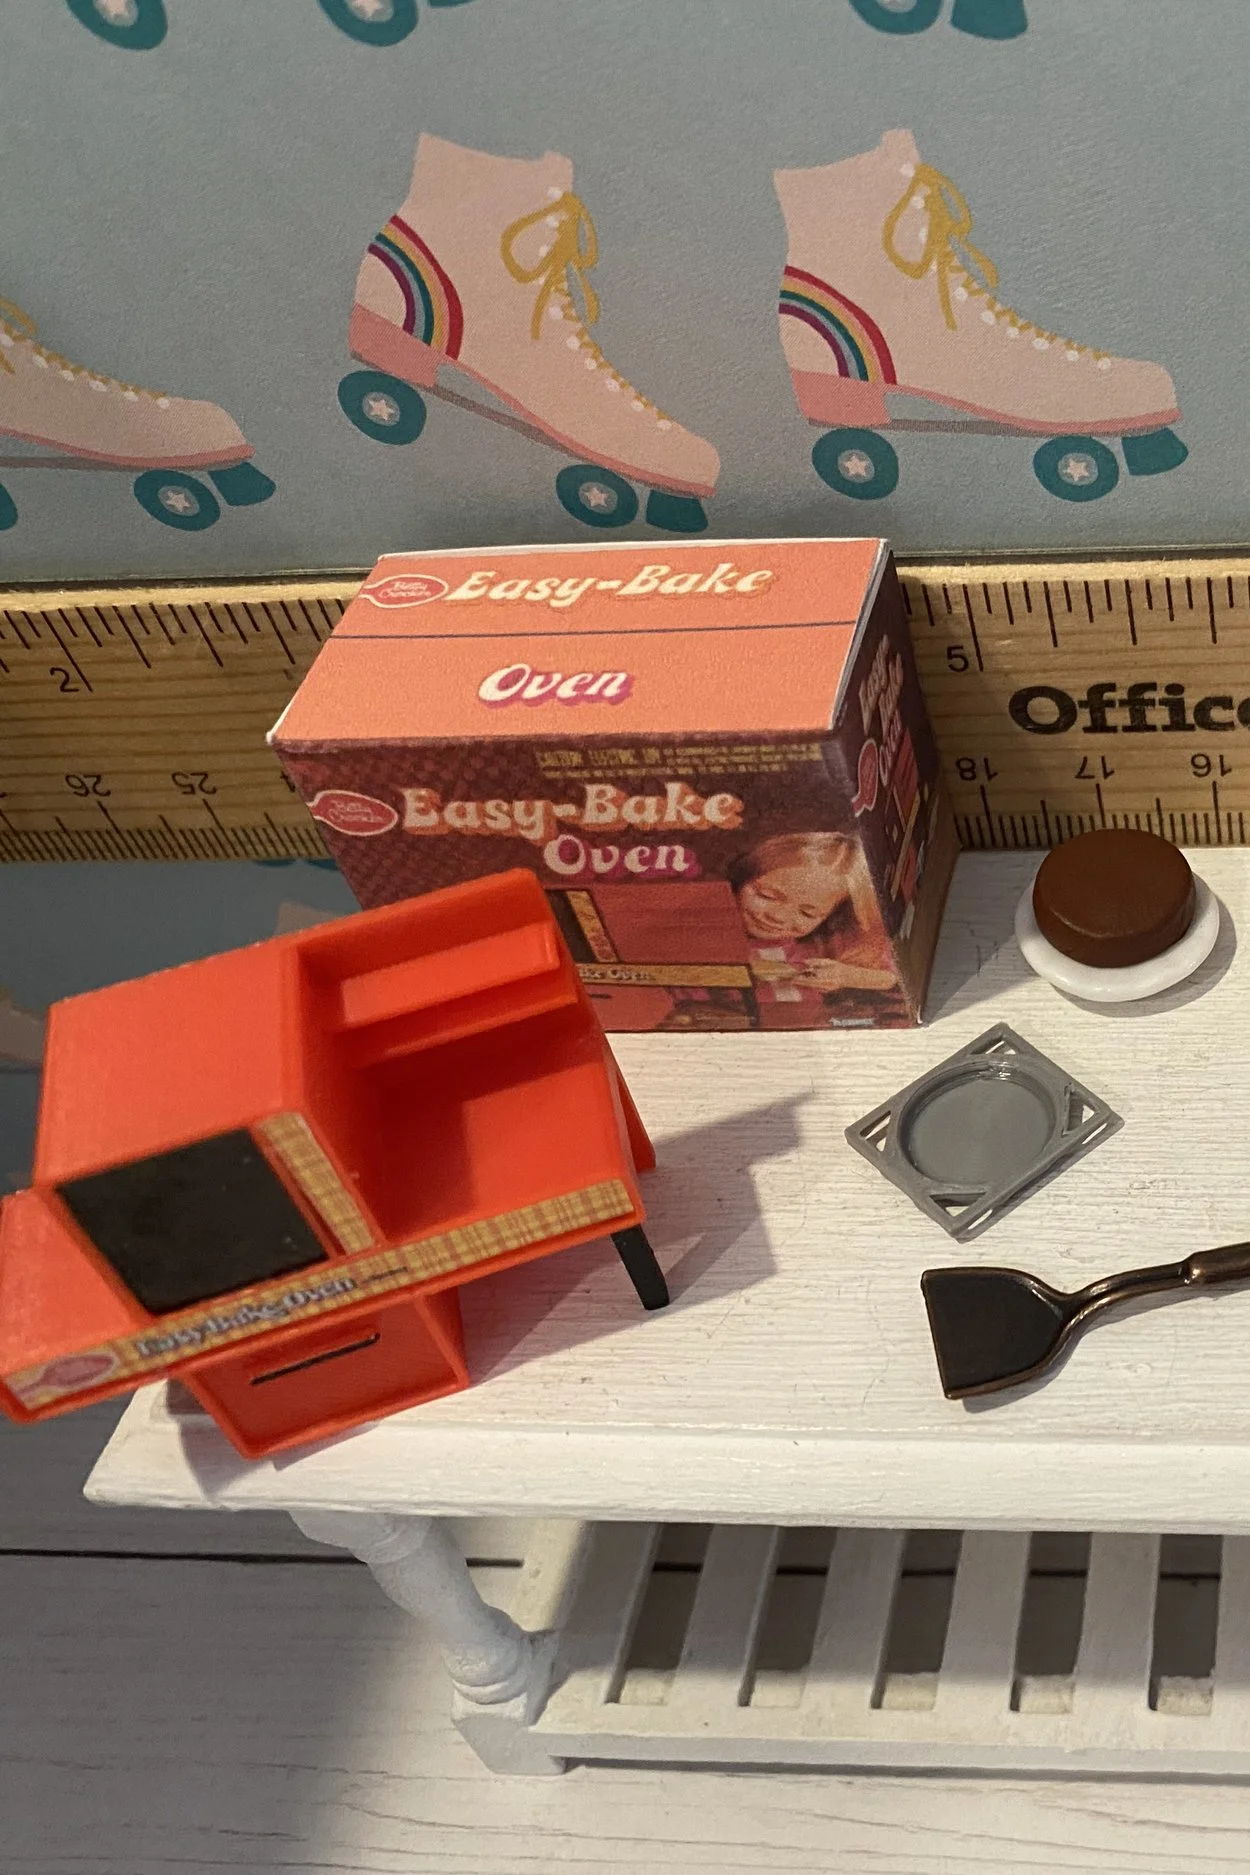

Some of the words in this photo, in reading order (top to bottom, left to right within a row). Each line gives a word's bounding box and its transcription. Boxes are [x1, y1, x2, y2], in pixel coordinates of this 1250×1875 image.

[445, 564, 776, 608] Easy-Bake
[946, 646, 970, 672] 5
[50, 667, 79, 692] 2
[479, 663, 632, 704] Oven
[955, 757, 998, 782] 18
[1075, 756, 1116, 781] 17
[1191, 754, 1233, 778] 16
[65, 774, 111, 797] 26
[171, 771, 217, 795] 25
[402, 782, 742, 842] Easy-Bake
[543, 834, 695, 877] Oven
